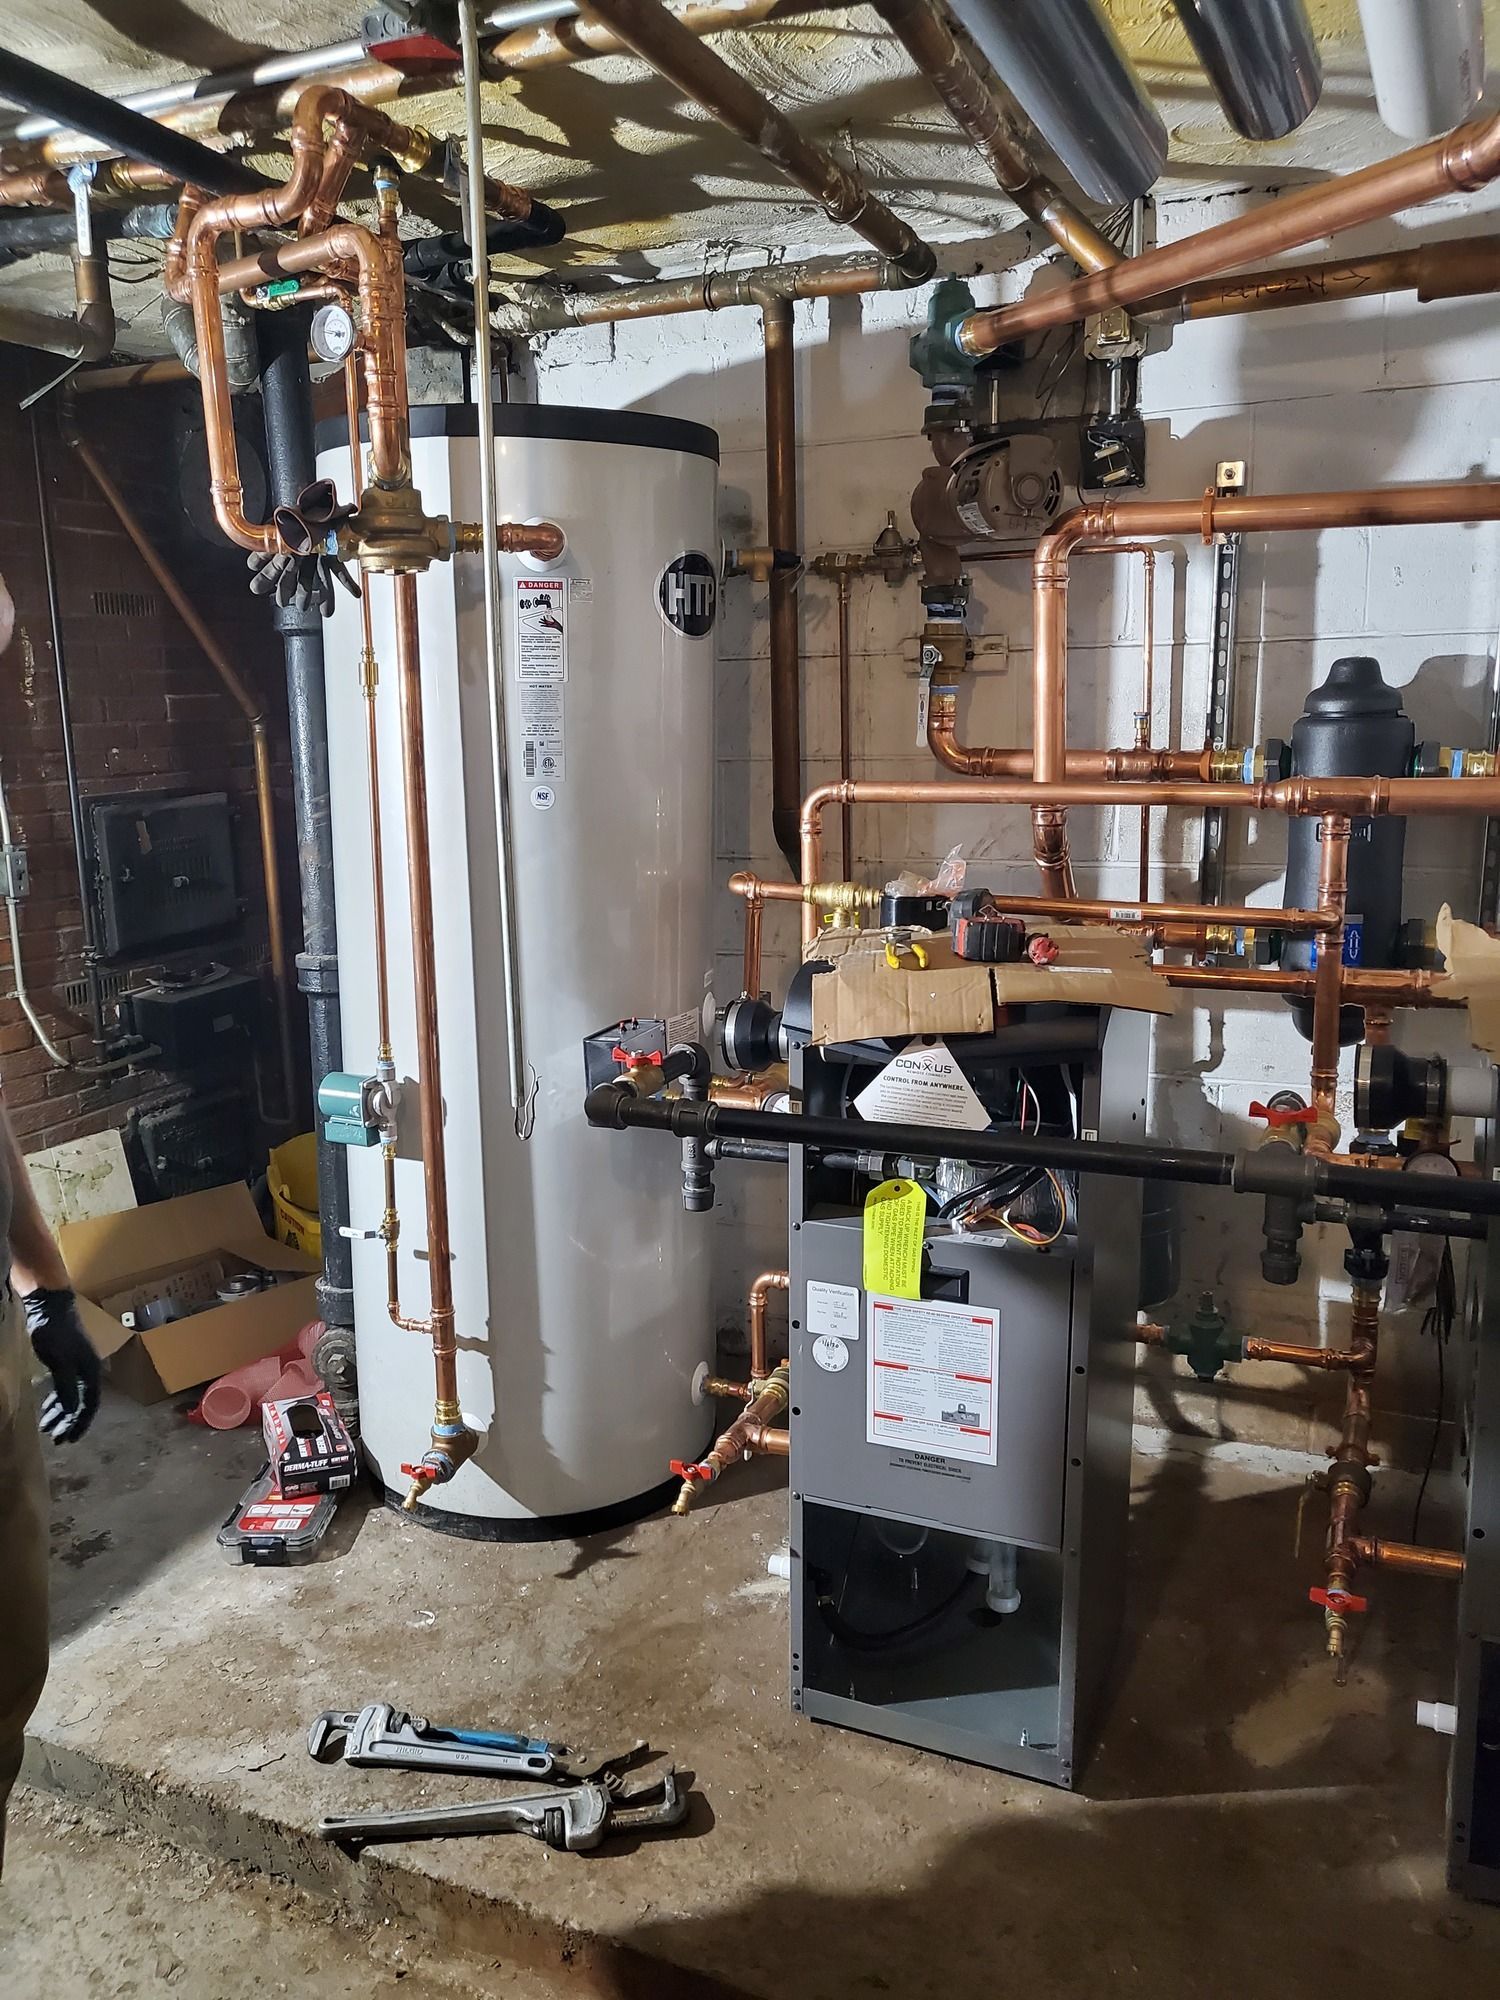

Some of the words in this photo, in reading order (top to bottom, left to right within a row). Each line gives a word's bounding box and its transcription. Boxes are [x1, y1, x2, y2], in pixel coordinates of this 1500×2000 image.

[668, 572, 715, 616] HTP
[883, 1075, 910, 1084] CONTROL
[911, 1078, 928, 1087] FROM
[930, 1081, 965, 1092] ANYWHERE.
[894, 1199, 899, 1208] OF
[280, 1208, 305, 1236] CAUTION
[899, 1217, 904, 1226] TO
[883, 1212, 891, 1248] TIGHTENING
[905, 1224, 910, 1232] UP
[901, 1280, 906, 1288] BE
[812, 1286, 828, 1294] Quality
[829, 1288, 855, 1297] Verification
[914, 1453, 946, 1464] DANGER
[284, 1458, 329, 1472] DERMA-TUFF
